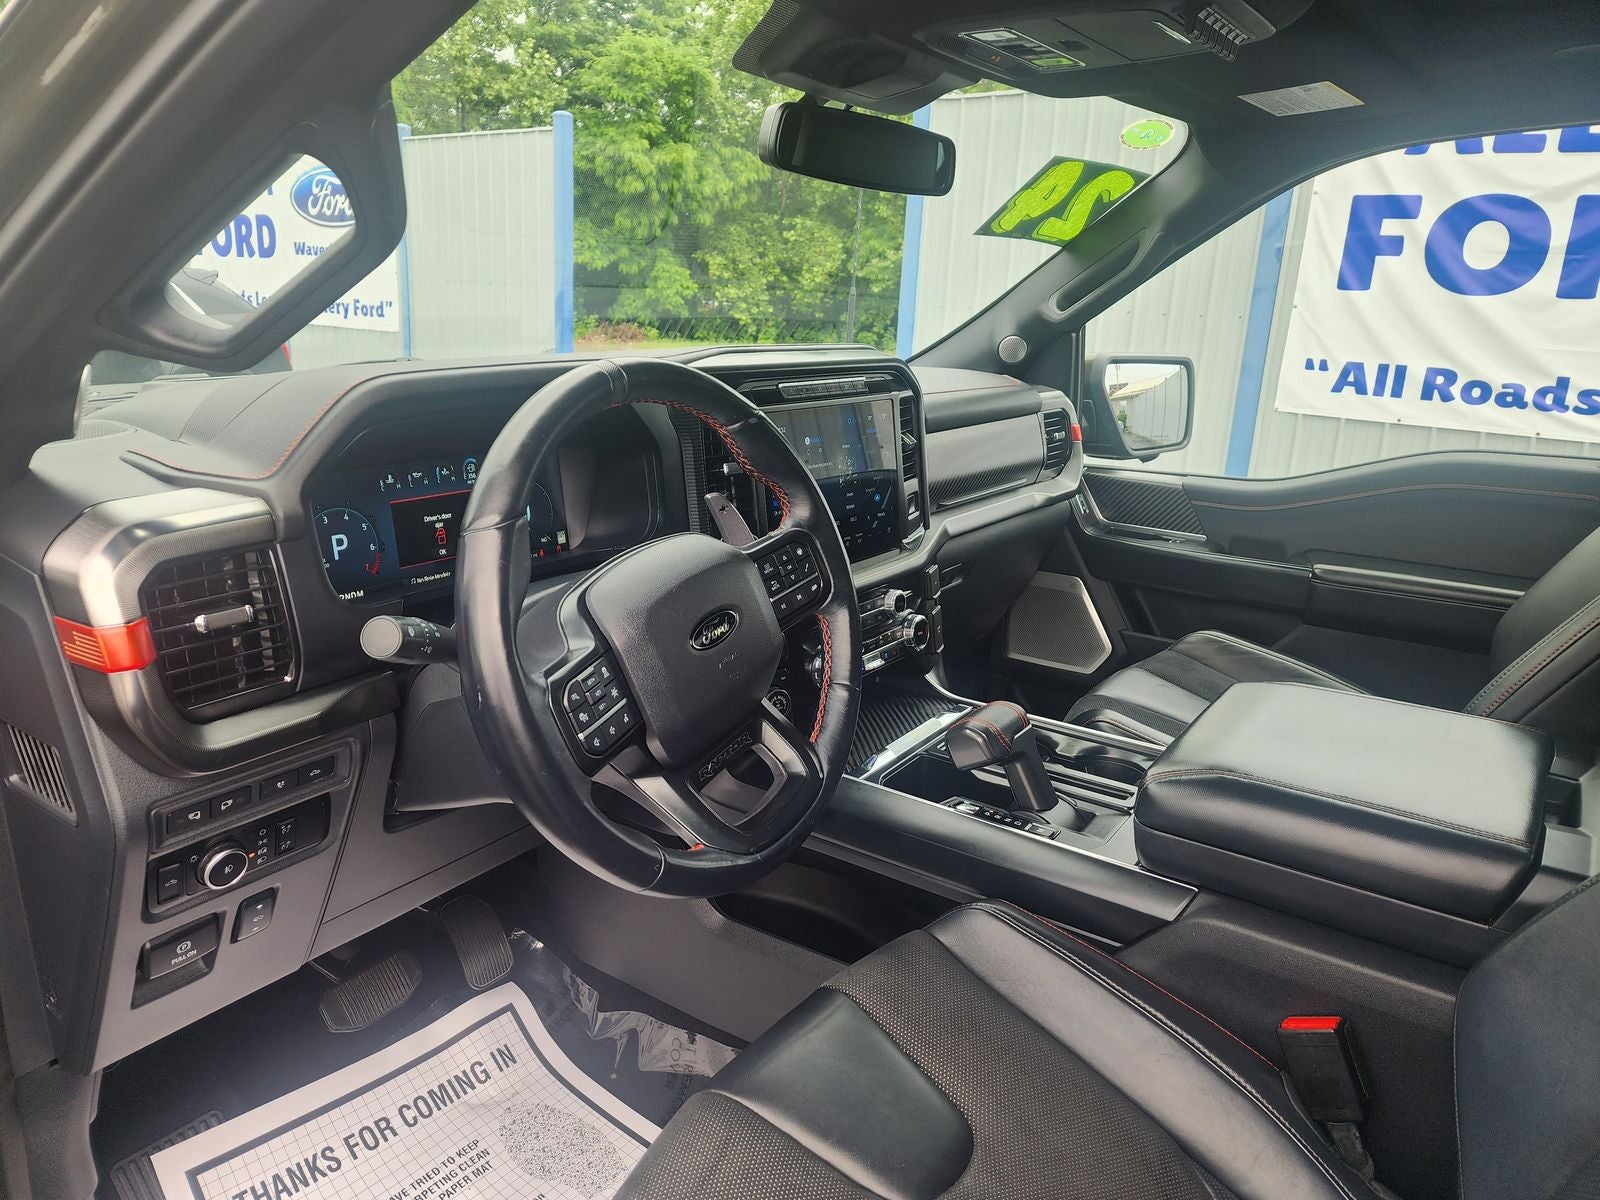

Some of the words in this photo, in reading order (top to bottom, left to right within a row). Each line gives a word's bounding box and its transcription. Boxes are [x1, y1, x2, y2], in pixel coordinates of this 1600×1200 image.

[204, 213, 277, 259] ORD
[1420, 366, 1600, 416] Roads
[331, 534, 348, 560] P
[438, 548, 447, 556] OK
[702, 616, 730, 645] Ford
[171, 955, 187, 965] PULL
[187, 949, 197, 957] ON
[232, 1145, 342, 1200] THANKS
[343, 1116, 399, 1160] FOR
[398, 1060, 491, 1128] COMING
[490, 1043, 518, 1073] IN
[409, 1167, 441, 1191] TRIED
[442, 1156, 456, 1170] TO
[456, 1138, 480, 1159] KEEP
[414, 1169, 459, 1200] RPETING
[459, 1148, 491, 1172] CLEAN
[438, 1176, 473, 1200] PAPER
[472, 1160, 494, 1179] MAT
